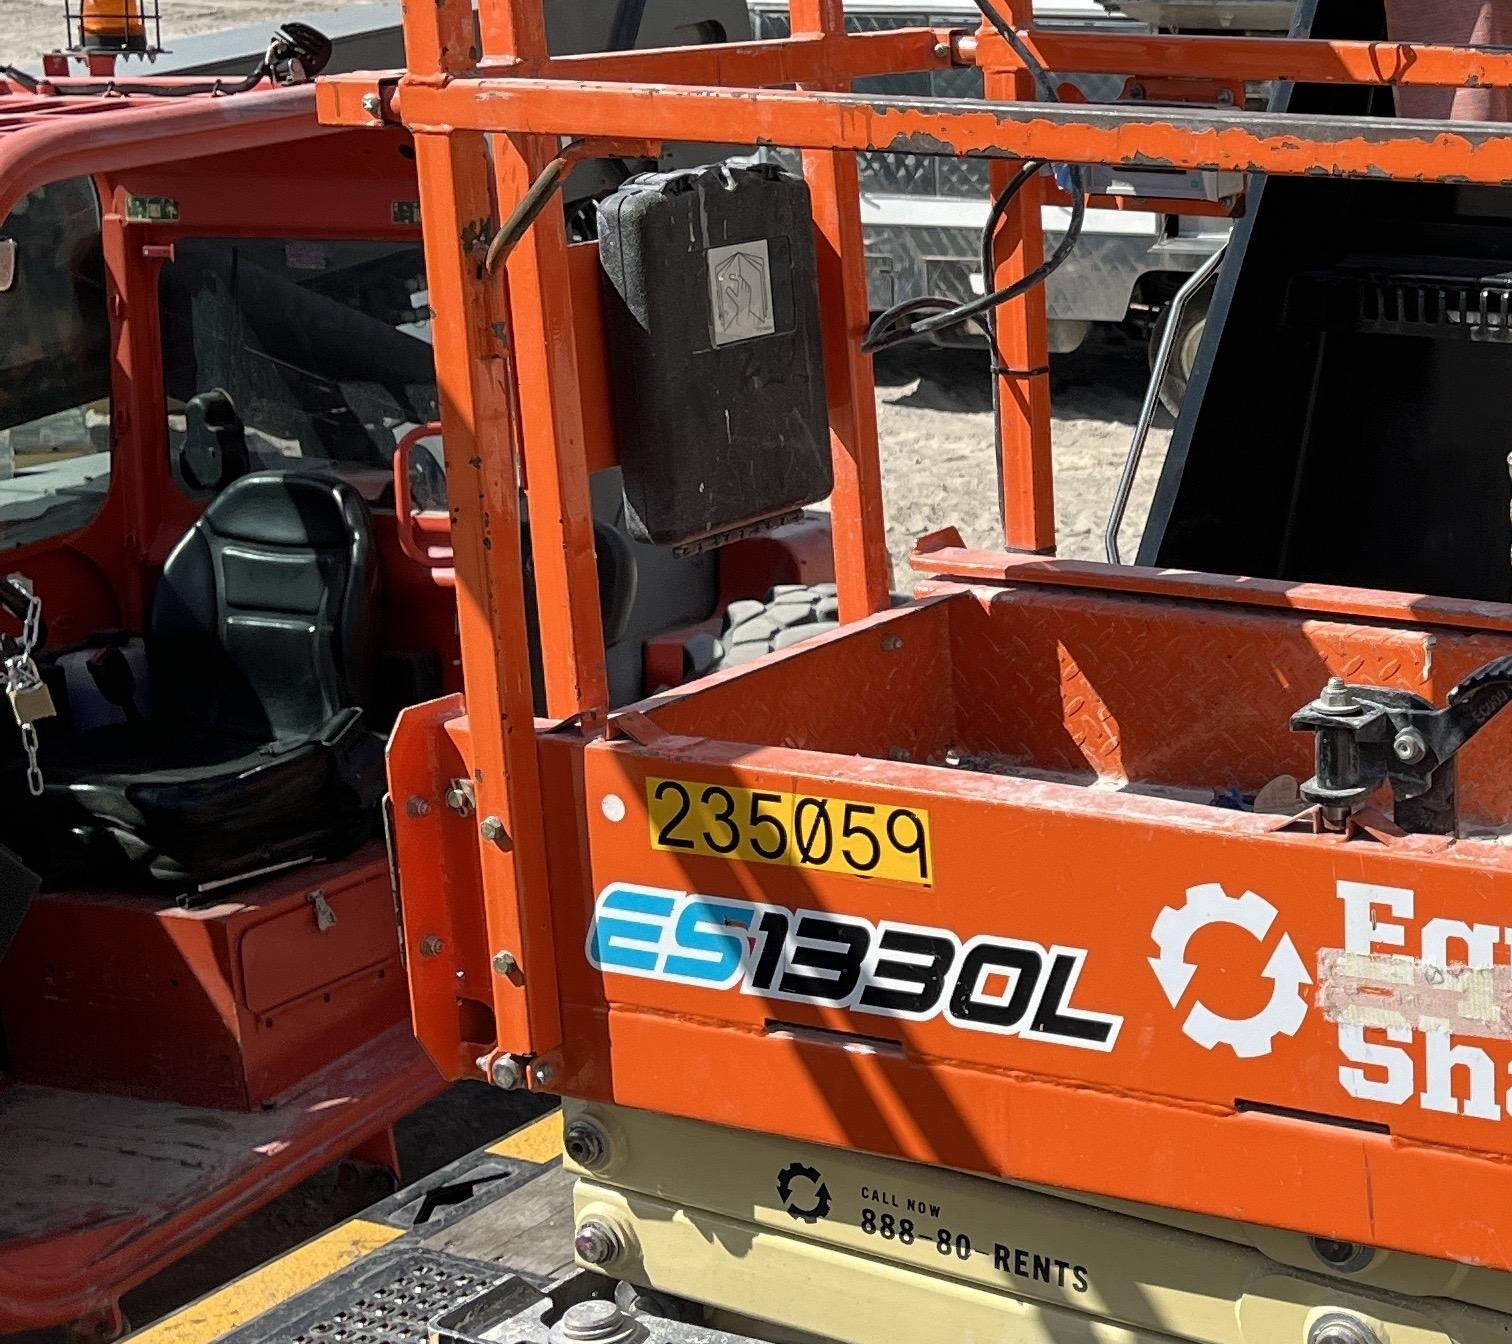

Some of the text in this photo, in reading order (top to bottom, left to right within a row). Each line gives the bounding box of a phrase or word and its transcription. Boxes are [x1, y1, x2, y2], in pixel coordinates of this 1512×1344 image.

[655, 779, 930, 879] 235059
[588, 883, 1123, 1051] ES1330L
[860, 1186, 942, 1218] CALL NOW
[859, 1208, 1090, 1294] 888-80-RENTS
